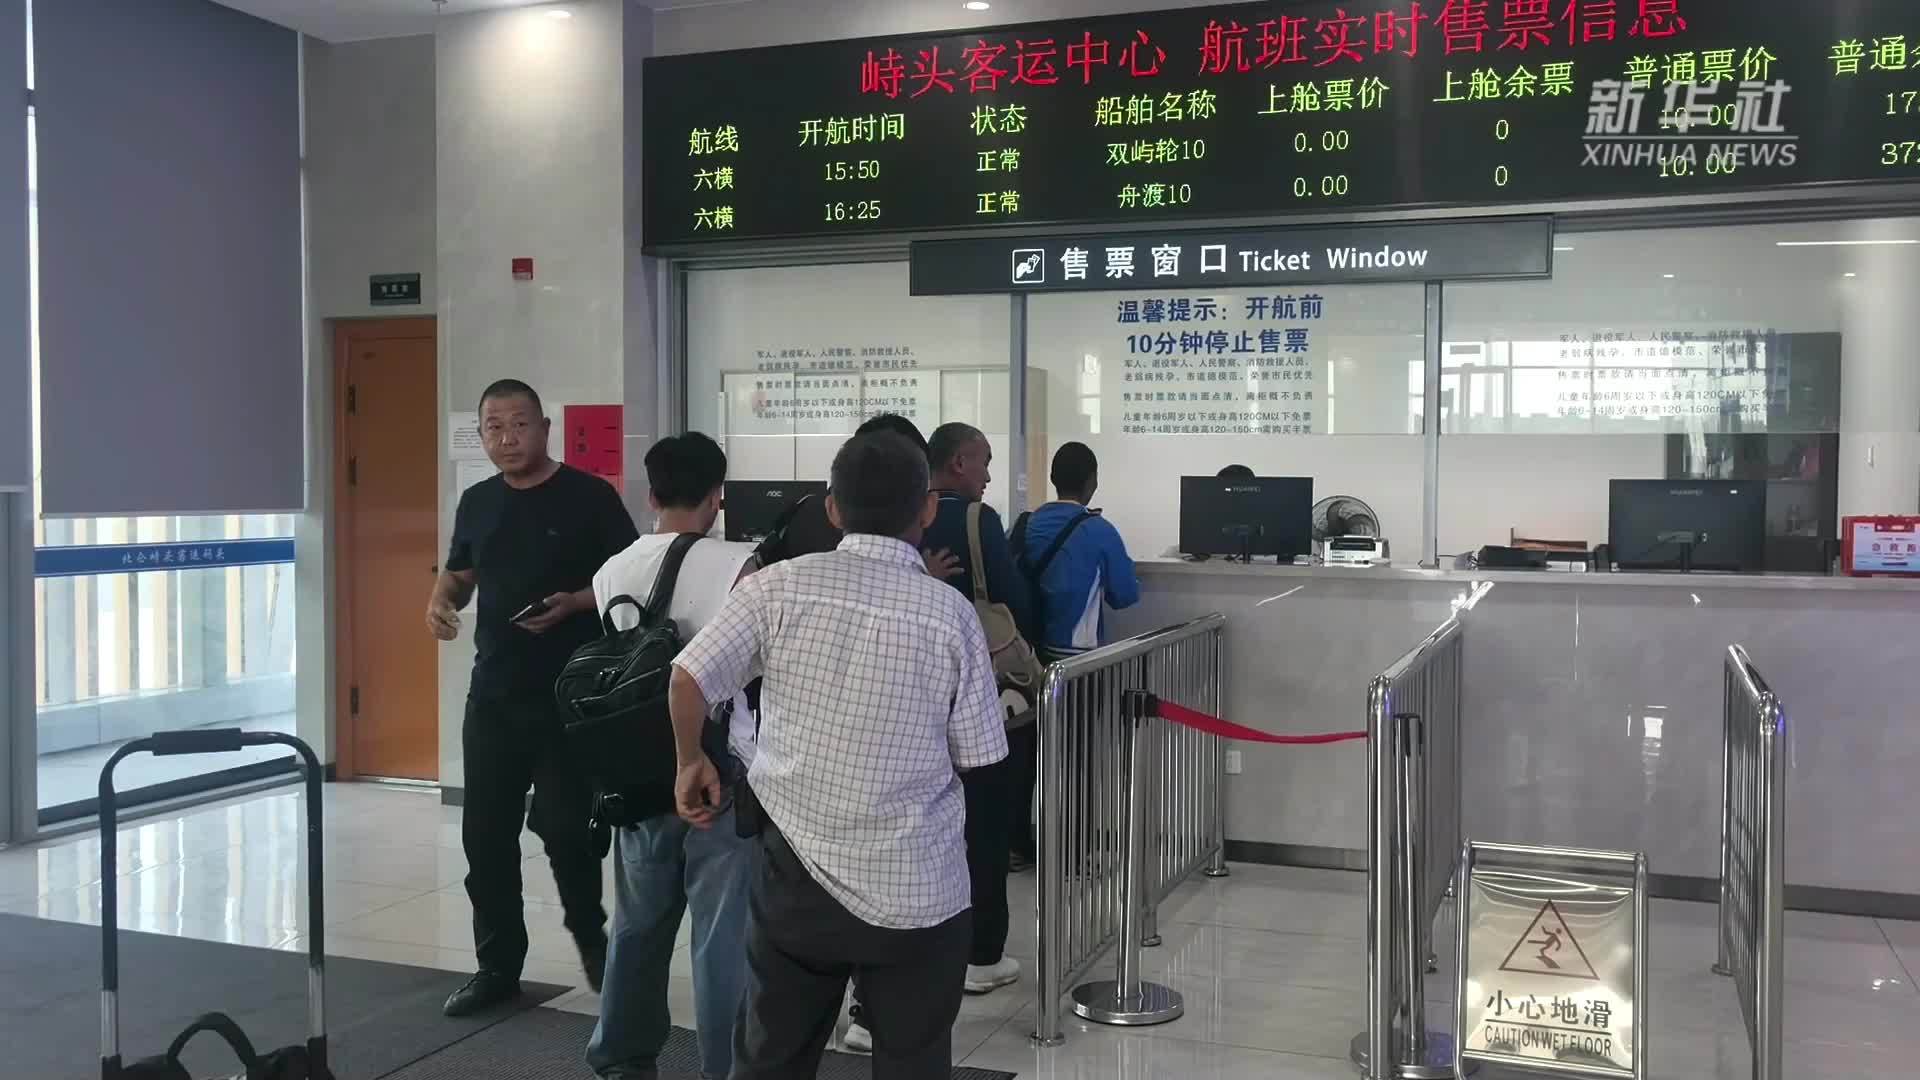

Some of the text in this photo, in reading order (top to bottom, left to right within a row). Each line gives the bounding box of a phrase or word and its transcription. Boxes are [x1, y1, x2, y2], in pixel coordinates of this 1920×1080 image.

[861, 0, 1688, 99] 峙头客运中心 航班实时售票信息
[688, 125, 739, 156] 航线
[798, 113, 905, 147] 开航时间
[970, 103, 1028, 136] 状态
[1094, 89, 1217, 127] 船舶名称
[1257, 76, 1391, 115] 上舱票价
[1432, 61, 1575, 102] 上舱余票
[1623, 46, 1777, 90] 普通票价
[693, 166, 734, 191] 六横
[825, 160, 880, 181] 15:50
[976, 147, 1021, 173] 正常
[1106, 138, 1205, 166] 双屿轮10
[1294, 130, 1349, 152] 0.00
[1495, 119, 1509, 140] 0
[1886, 91, 1920, 115] 17
[693, 205, 734, 230] 六横
[825, 200, 881, 221] 16:25
[976, 189, 1021, 215] 正常
[1117, 183, 1192, 209] 舟渡10
[1294, 175, 1348, 197] 0.00
[1494, 165, 1508, 186] 0
[1881, 141, 1920, 165] 37
[1059, 244, 1428, 280] 售票窗口 Ticket Window
[1127, 328, 1309, 355] 10分钟停止售票
[1486, 989, 1612, 1029] 小心地滑
